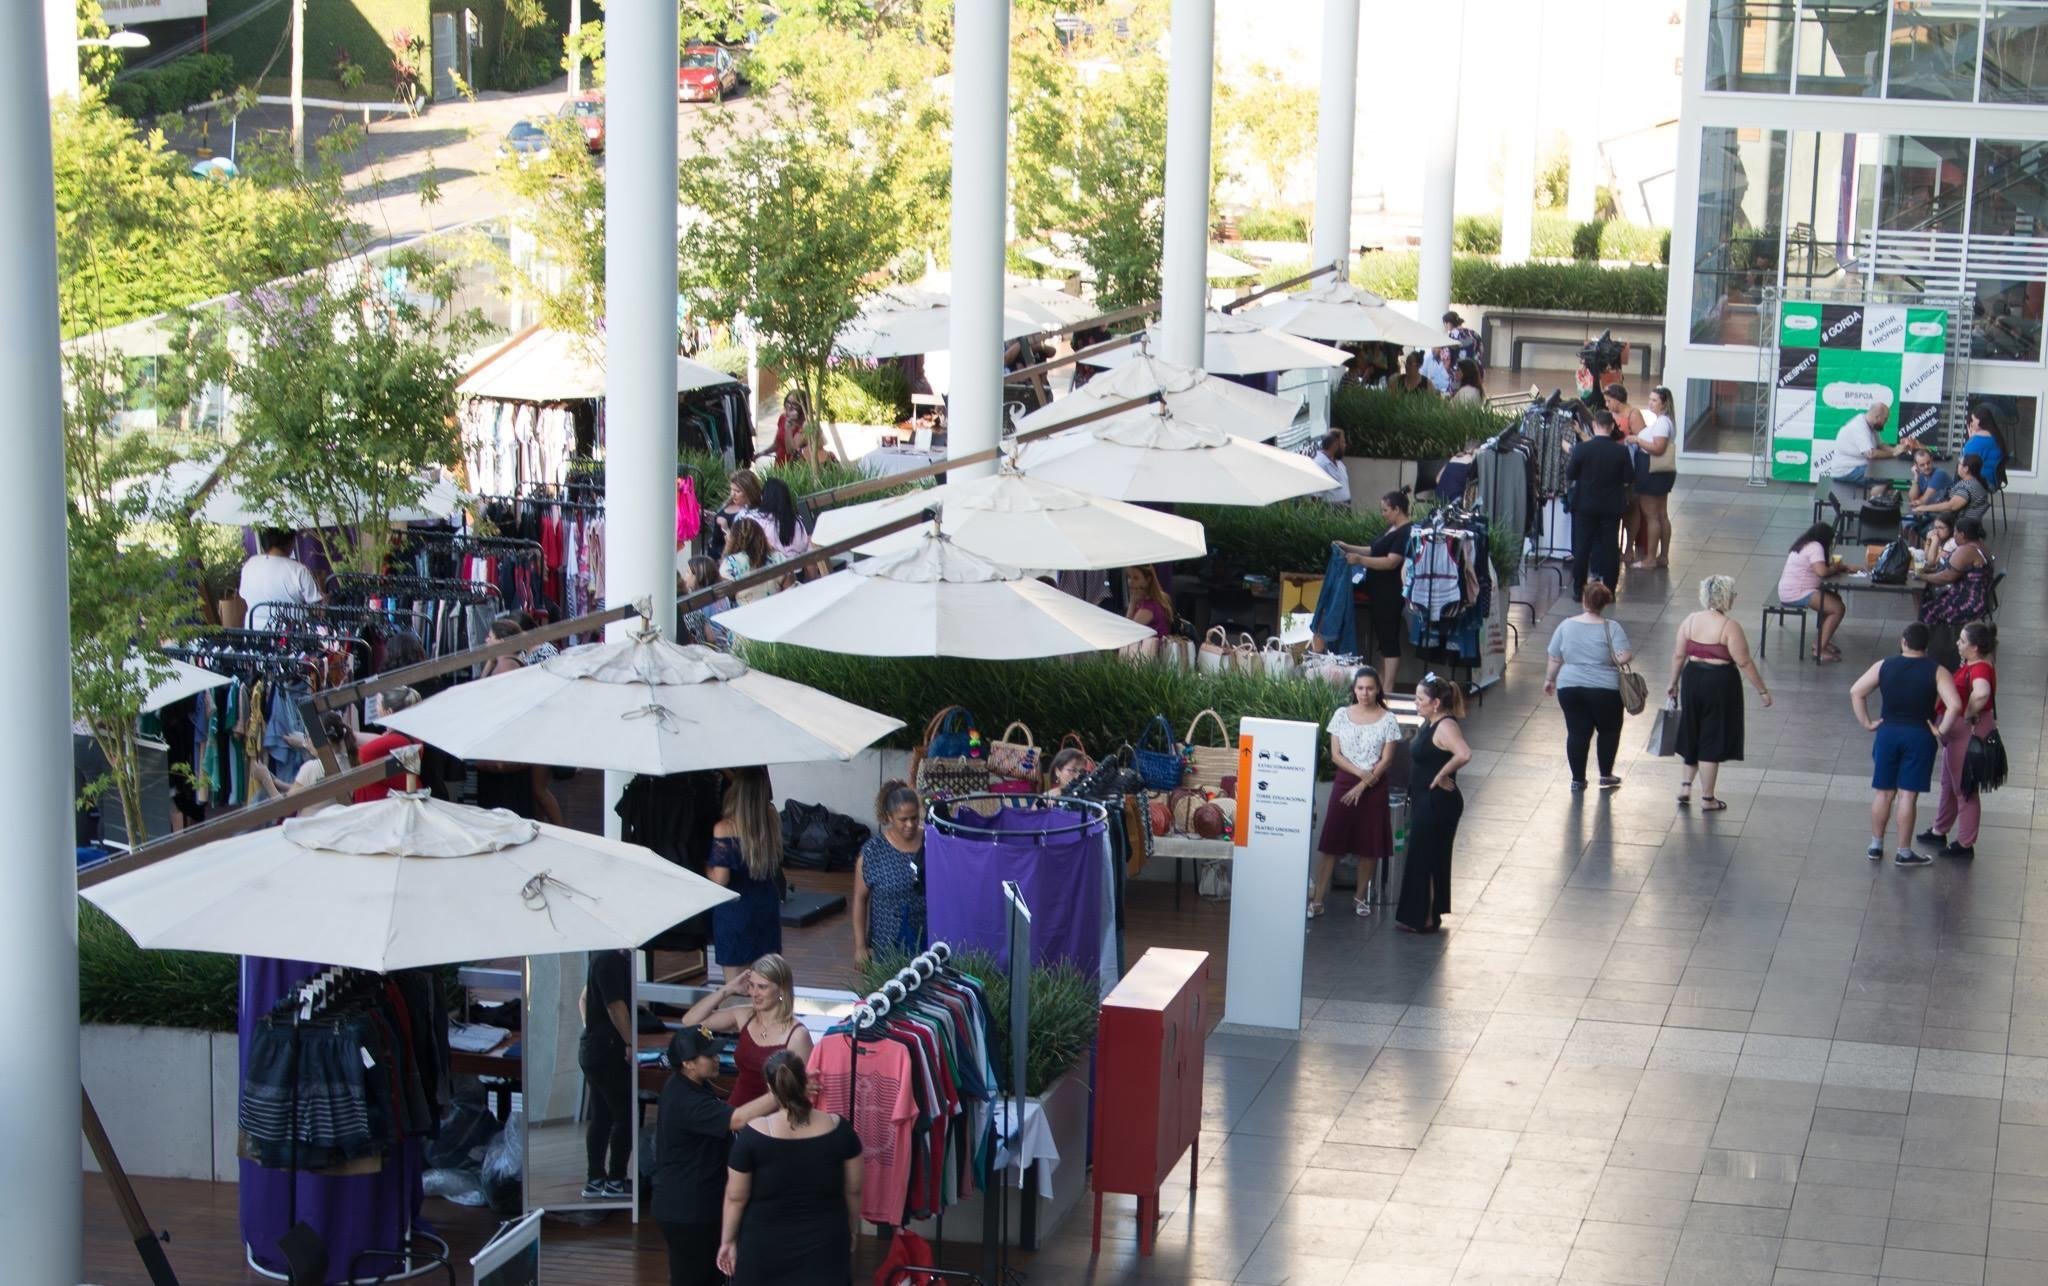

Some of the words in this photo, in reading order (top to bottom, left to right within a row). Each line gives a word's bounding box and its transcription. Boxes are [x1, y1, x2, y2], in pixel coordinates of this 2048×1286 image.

[1821, 311, 1862, 343] #GORDA
[1779, 353, 1817, 388] #RESPEITO
[1904, 361, 1943, 394] #PLUSSIZE
[1898, 405, 1938, 437] #TAMANHOS
